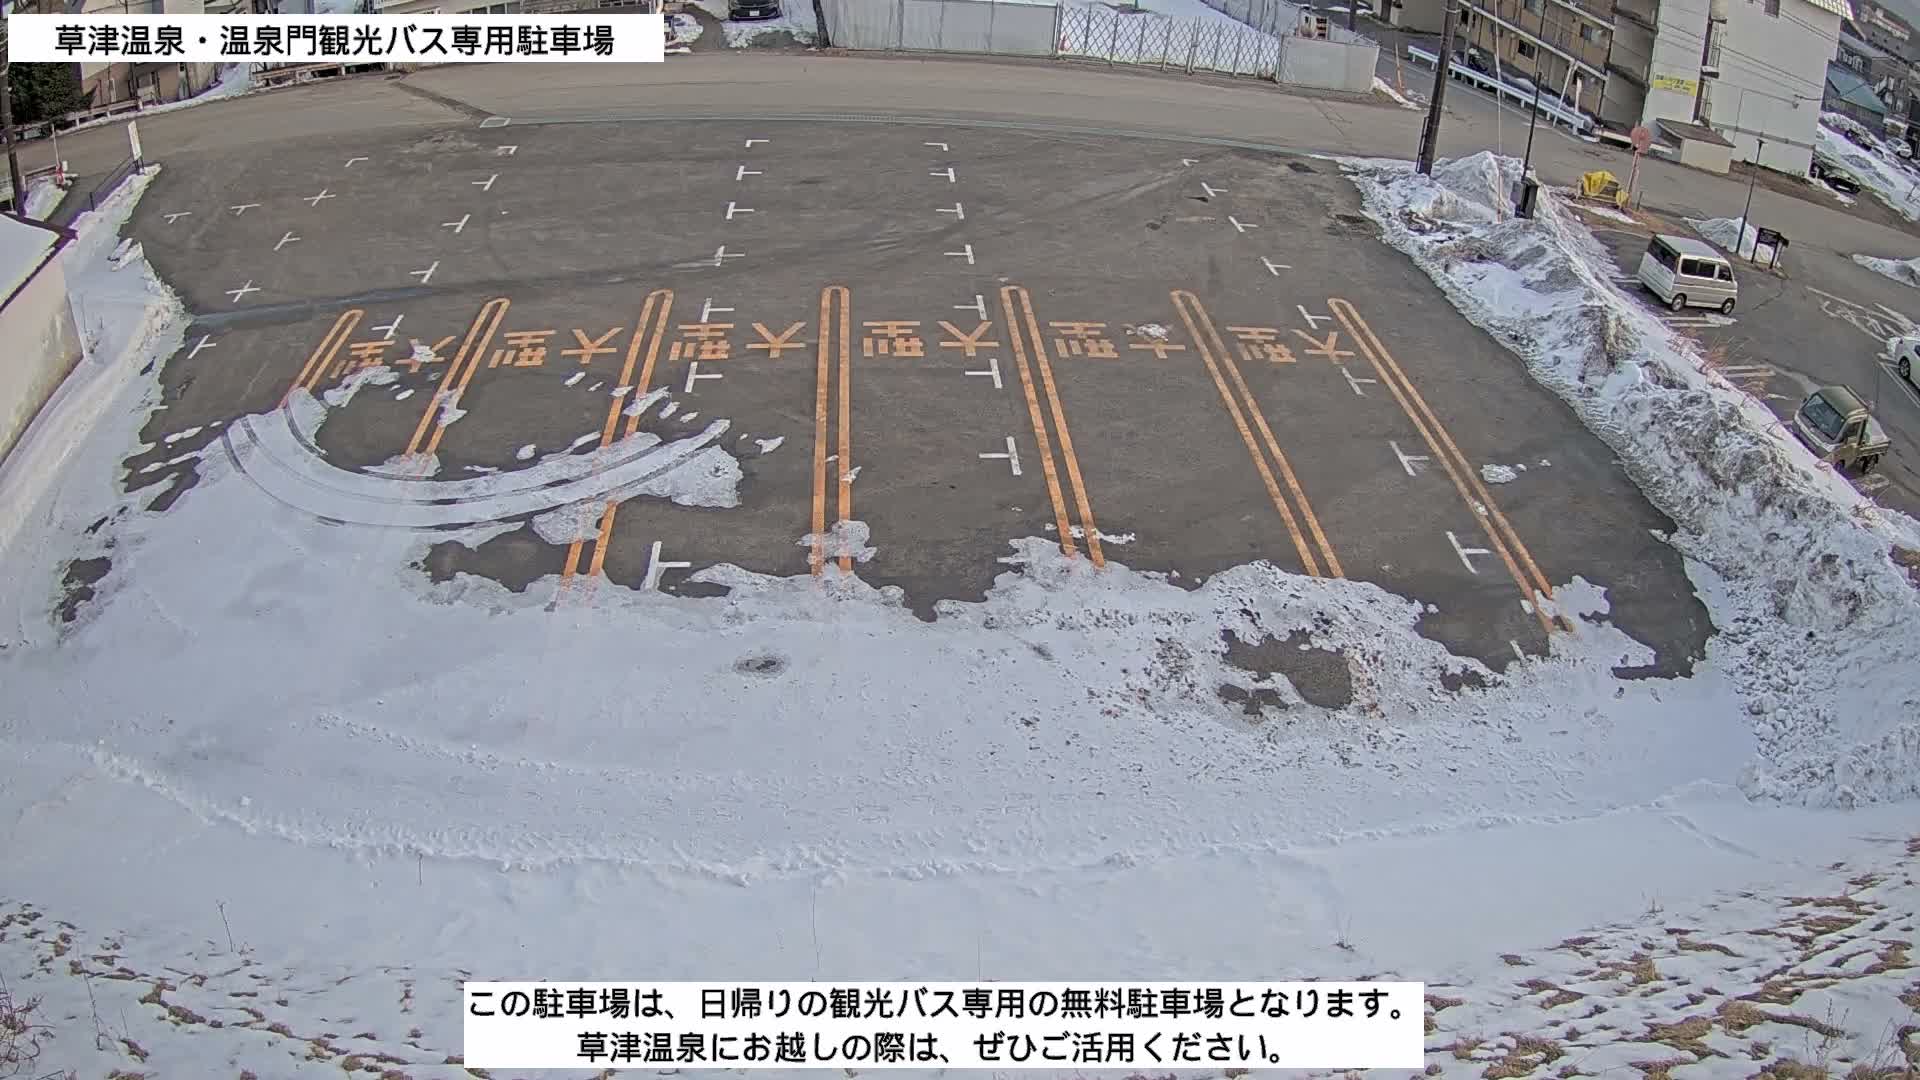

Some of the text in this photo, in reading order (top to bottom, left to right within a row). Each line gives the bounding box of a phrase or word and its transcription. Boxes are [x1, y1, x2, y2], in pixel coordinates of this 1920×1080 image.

[489, 327, 625, 368] 大型
[668, 321, 807, 361] 大型
[863, 320, 999, 357] 大型
[1226, 326, 1356, 363] 大型
